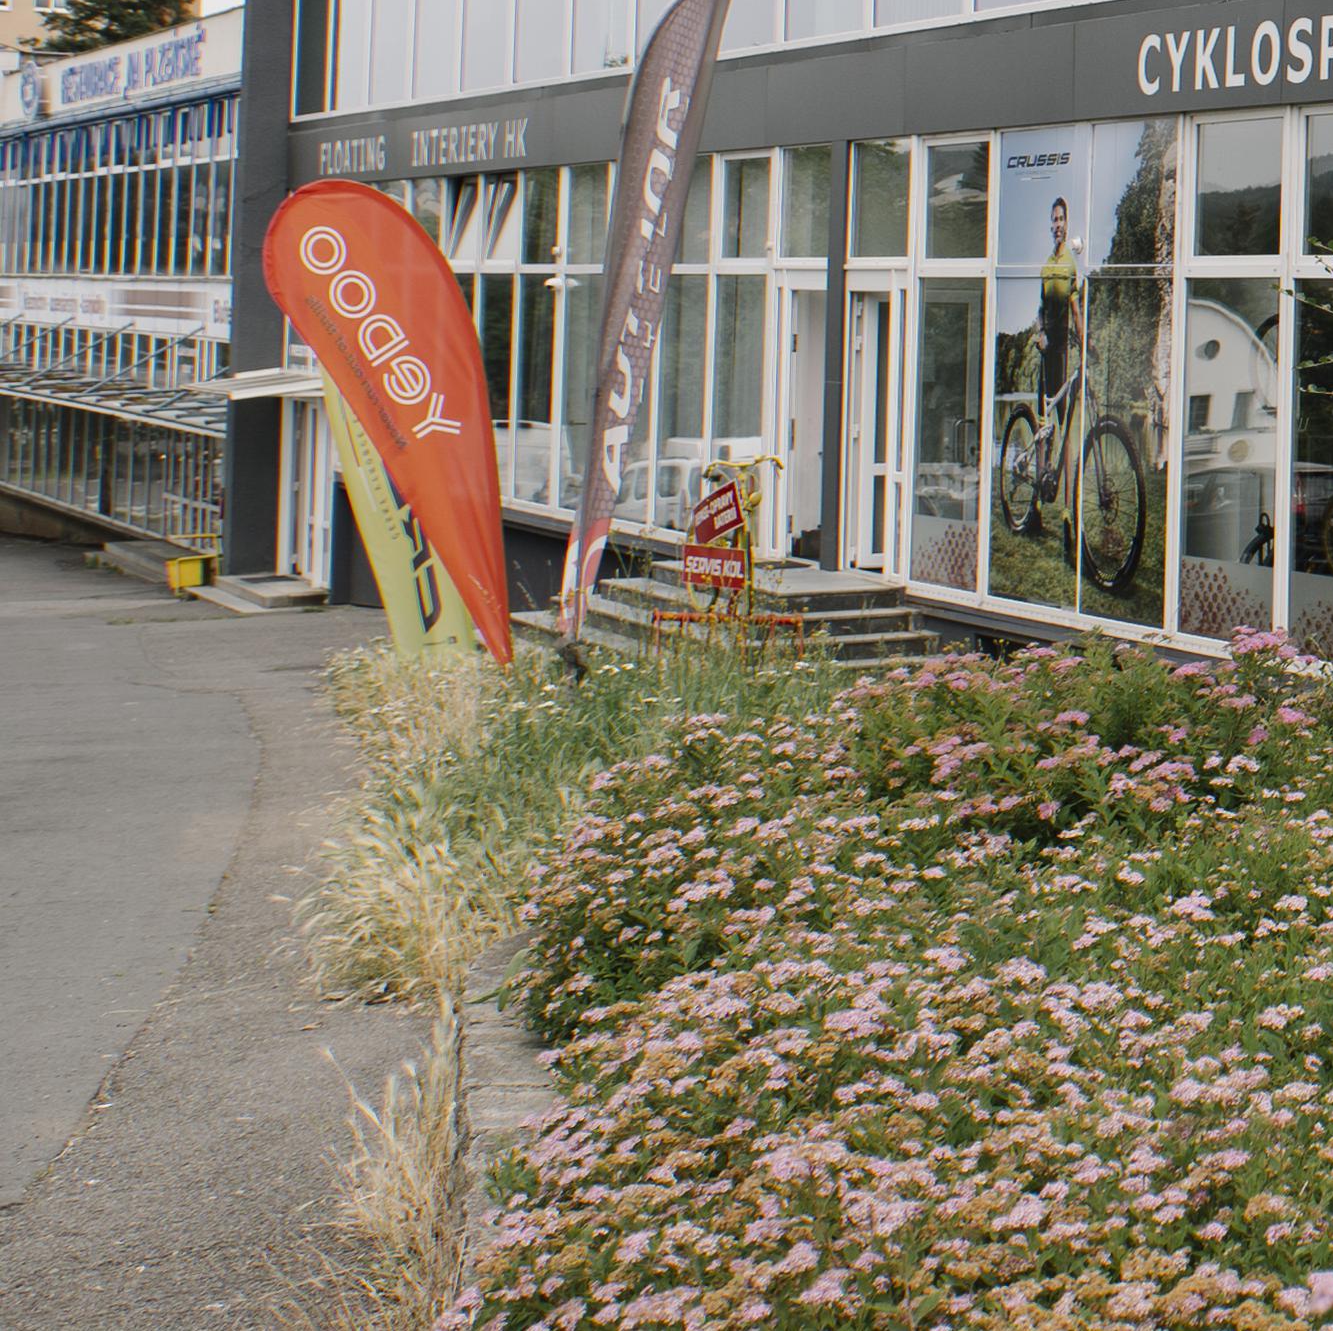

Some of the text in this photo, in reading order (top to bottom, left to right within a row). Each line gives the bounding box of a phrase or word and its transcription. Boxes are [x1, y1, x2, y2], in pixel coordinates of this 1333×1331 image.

[318, 135, 387, 175] FLOATING
[411, 118, 529, 167] INTERIERY HK
[1007, 152, 1071, 169] CRUSSIS
[685, 555, 745, 578] SERVIS KOL
